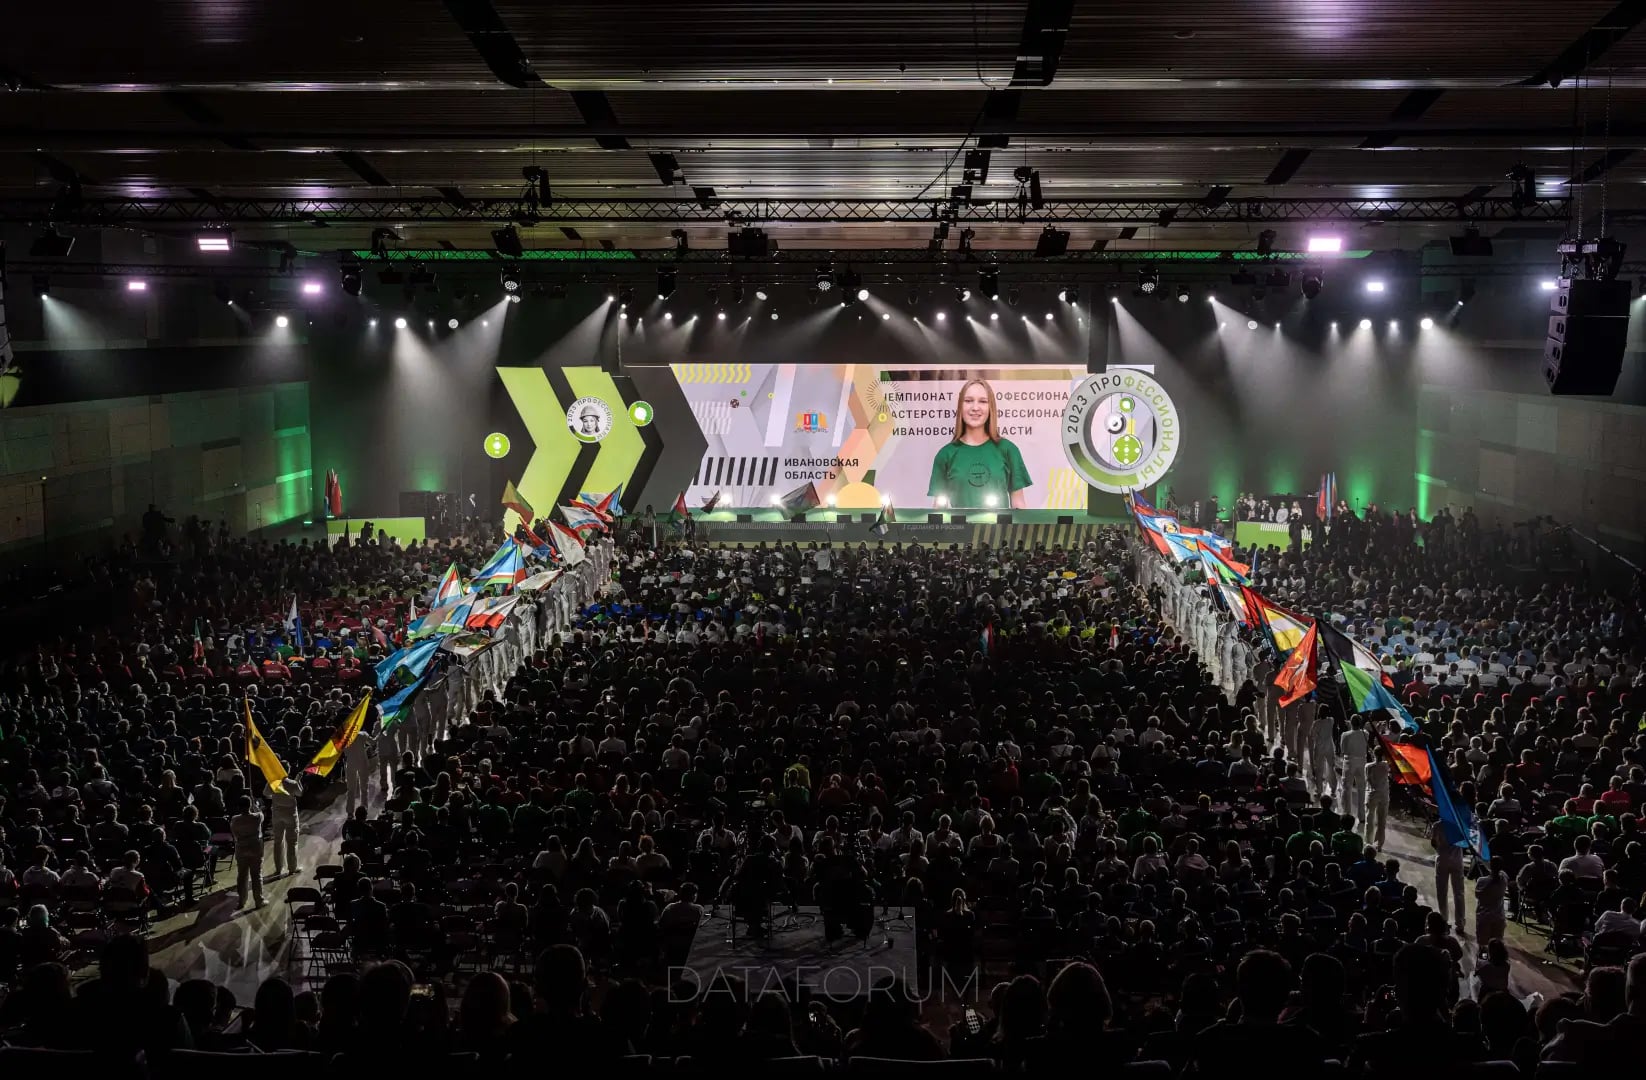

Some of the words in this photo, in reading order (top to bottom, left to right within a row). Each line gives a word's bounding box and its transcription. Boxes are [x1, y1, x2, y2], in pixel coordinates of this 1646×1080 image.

[995, 391, 1069, 401] ОФЕССИОНА
[891, 409, 958, 419] АСТЕРСТВУ
[892, 426, 955, 436] ИВАНОВСК
[996, 426, 1033, 436] АСТИ
[1067, 395, 1088, 434] 2023
[1089, 374, 1174, 480] ПРОФЕССИОНАЛЫ
[784, 458, 859, 467] ИВАНОВСКАЯ
[784, 470, 836, 480] ОБЛАСТЬ
